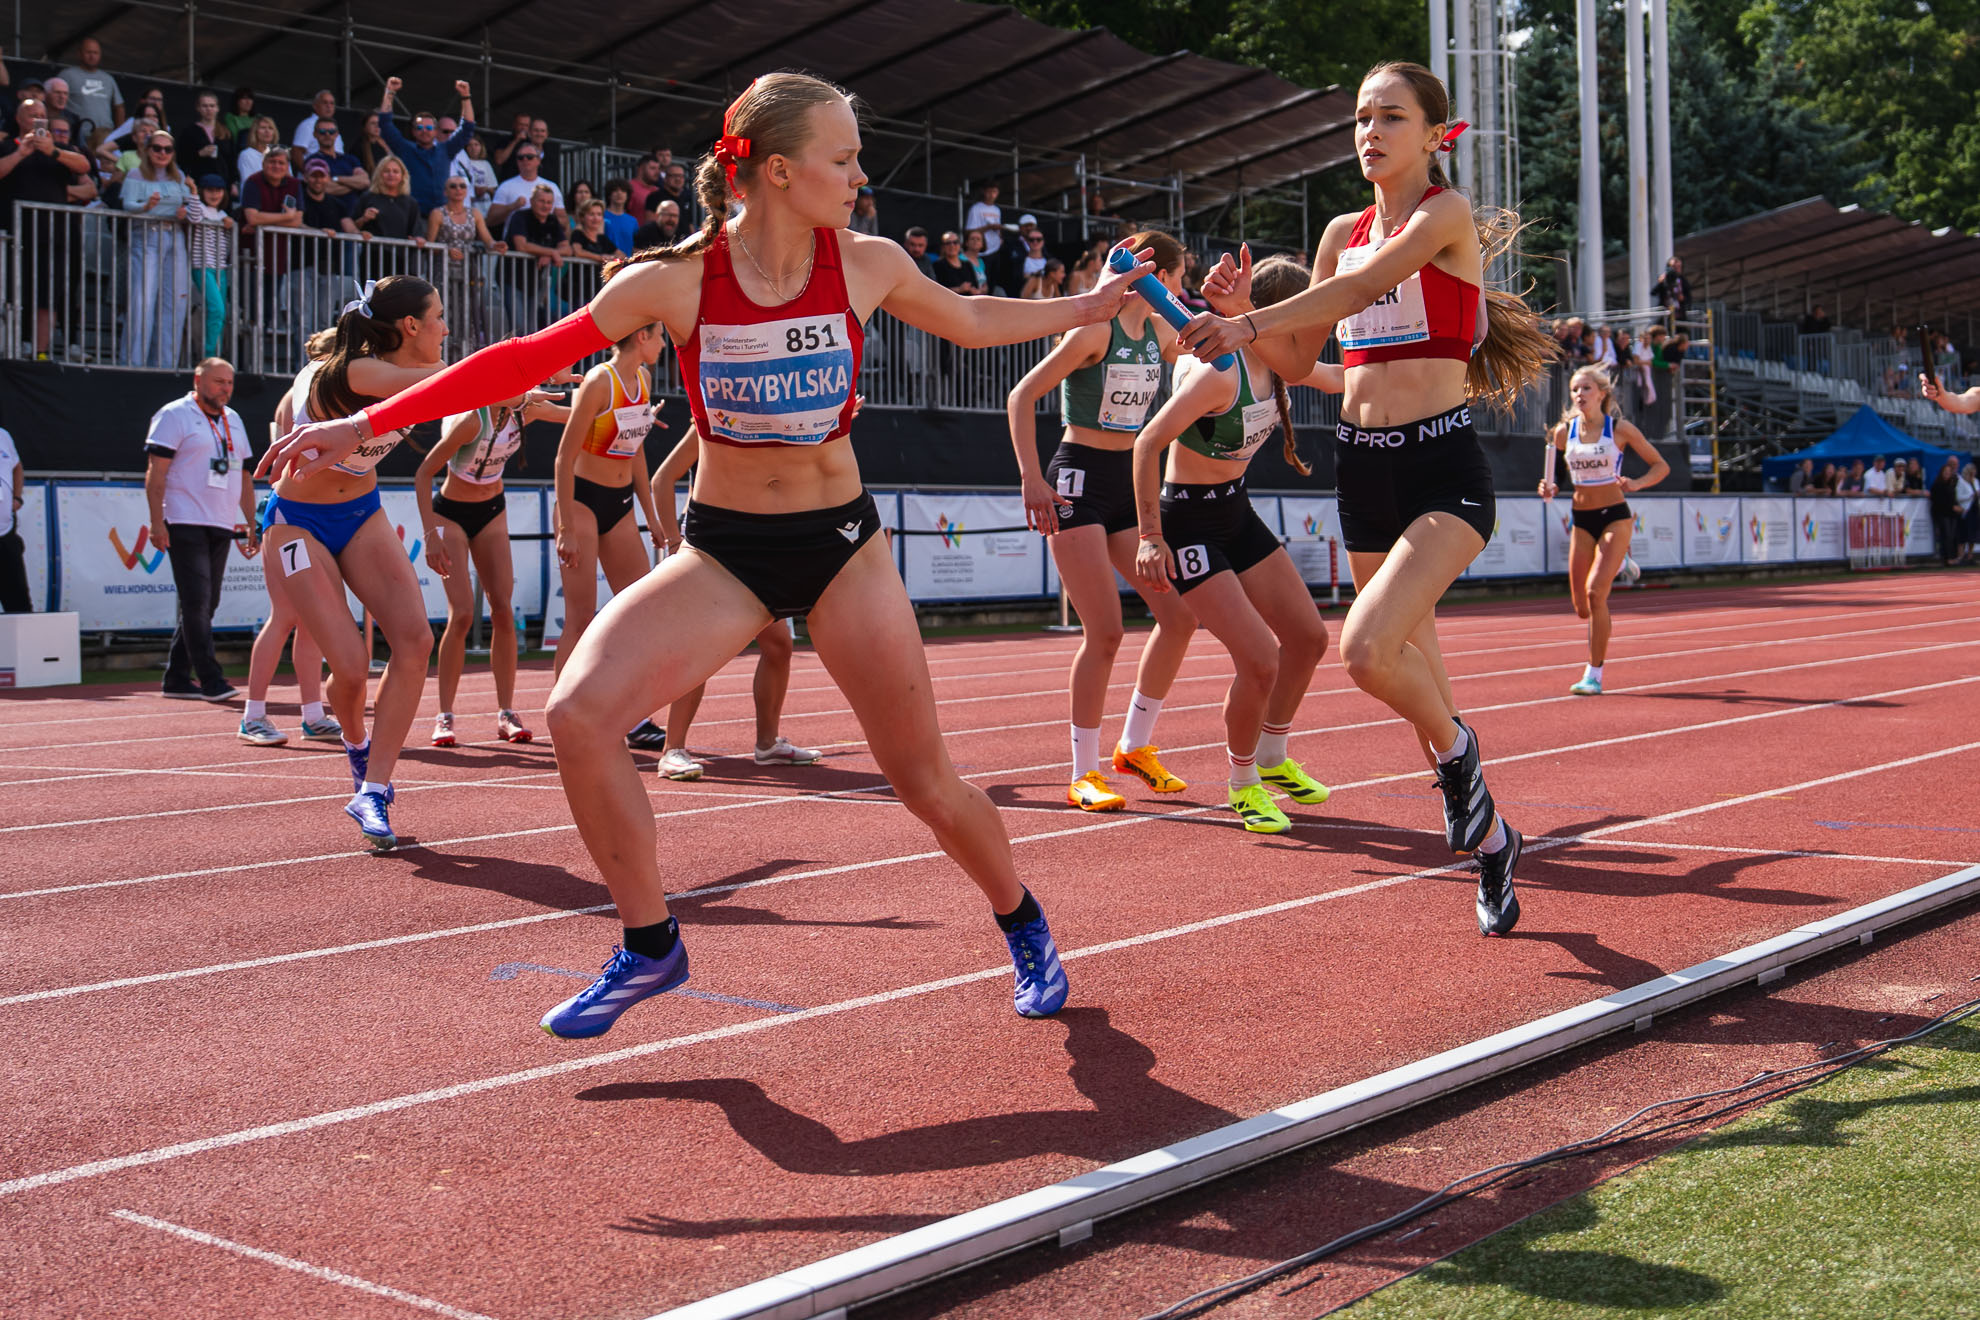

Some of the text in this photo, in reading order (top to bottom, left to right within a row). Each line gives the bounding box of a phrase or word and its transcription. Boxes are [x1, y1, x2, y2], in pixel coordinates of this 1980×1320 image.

[722, 343, 741, 351] Sportu
[744, 342, 769, 350] Turystyki
[785, 323, 839, 353] 851
[705, 365, 849, 403] PRZYBYLSKA
[1353, 431, 1406, 448] PRO
[1418, 408, 1472, 442] NIKE
[1065, 471, 1077, 494] 1
[283, 543, 298, 571] 7
[1184, 548, 1202, 574] 8
[104, 584, 176, 594] WIELKOPOLSKA
